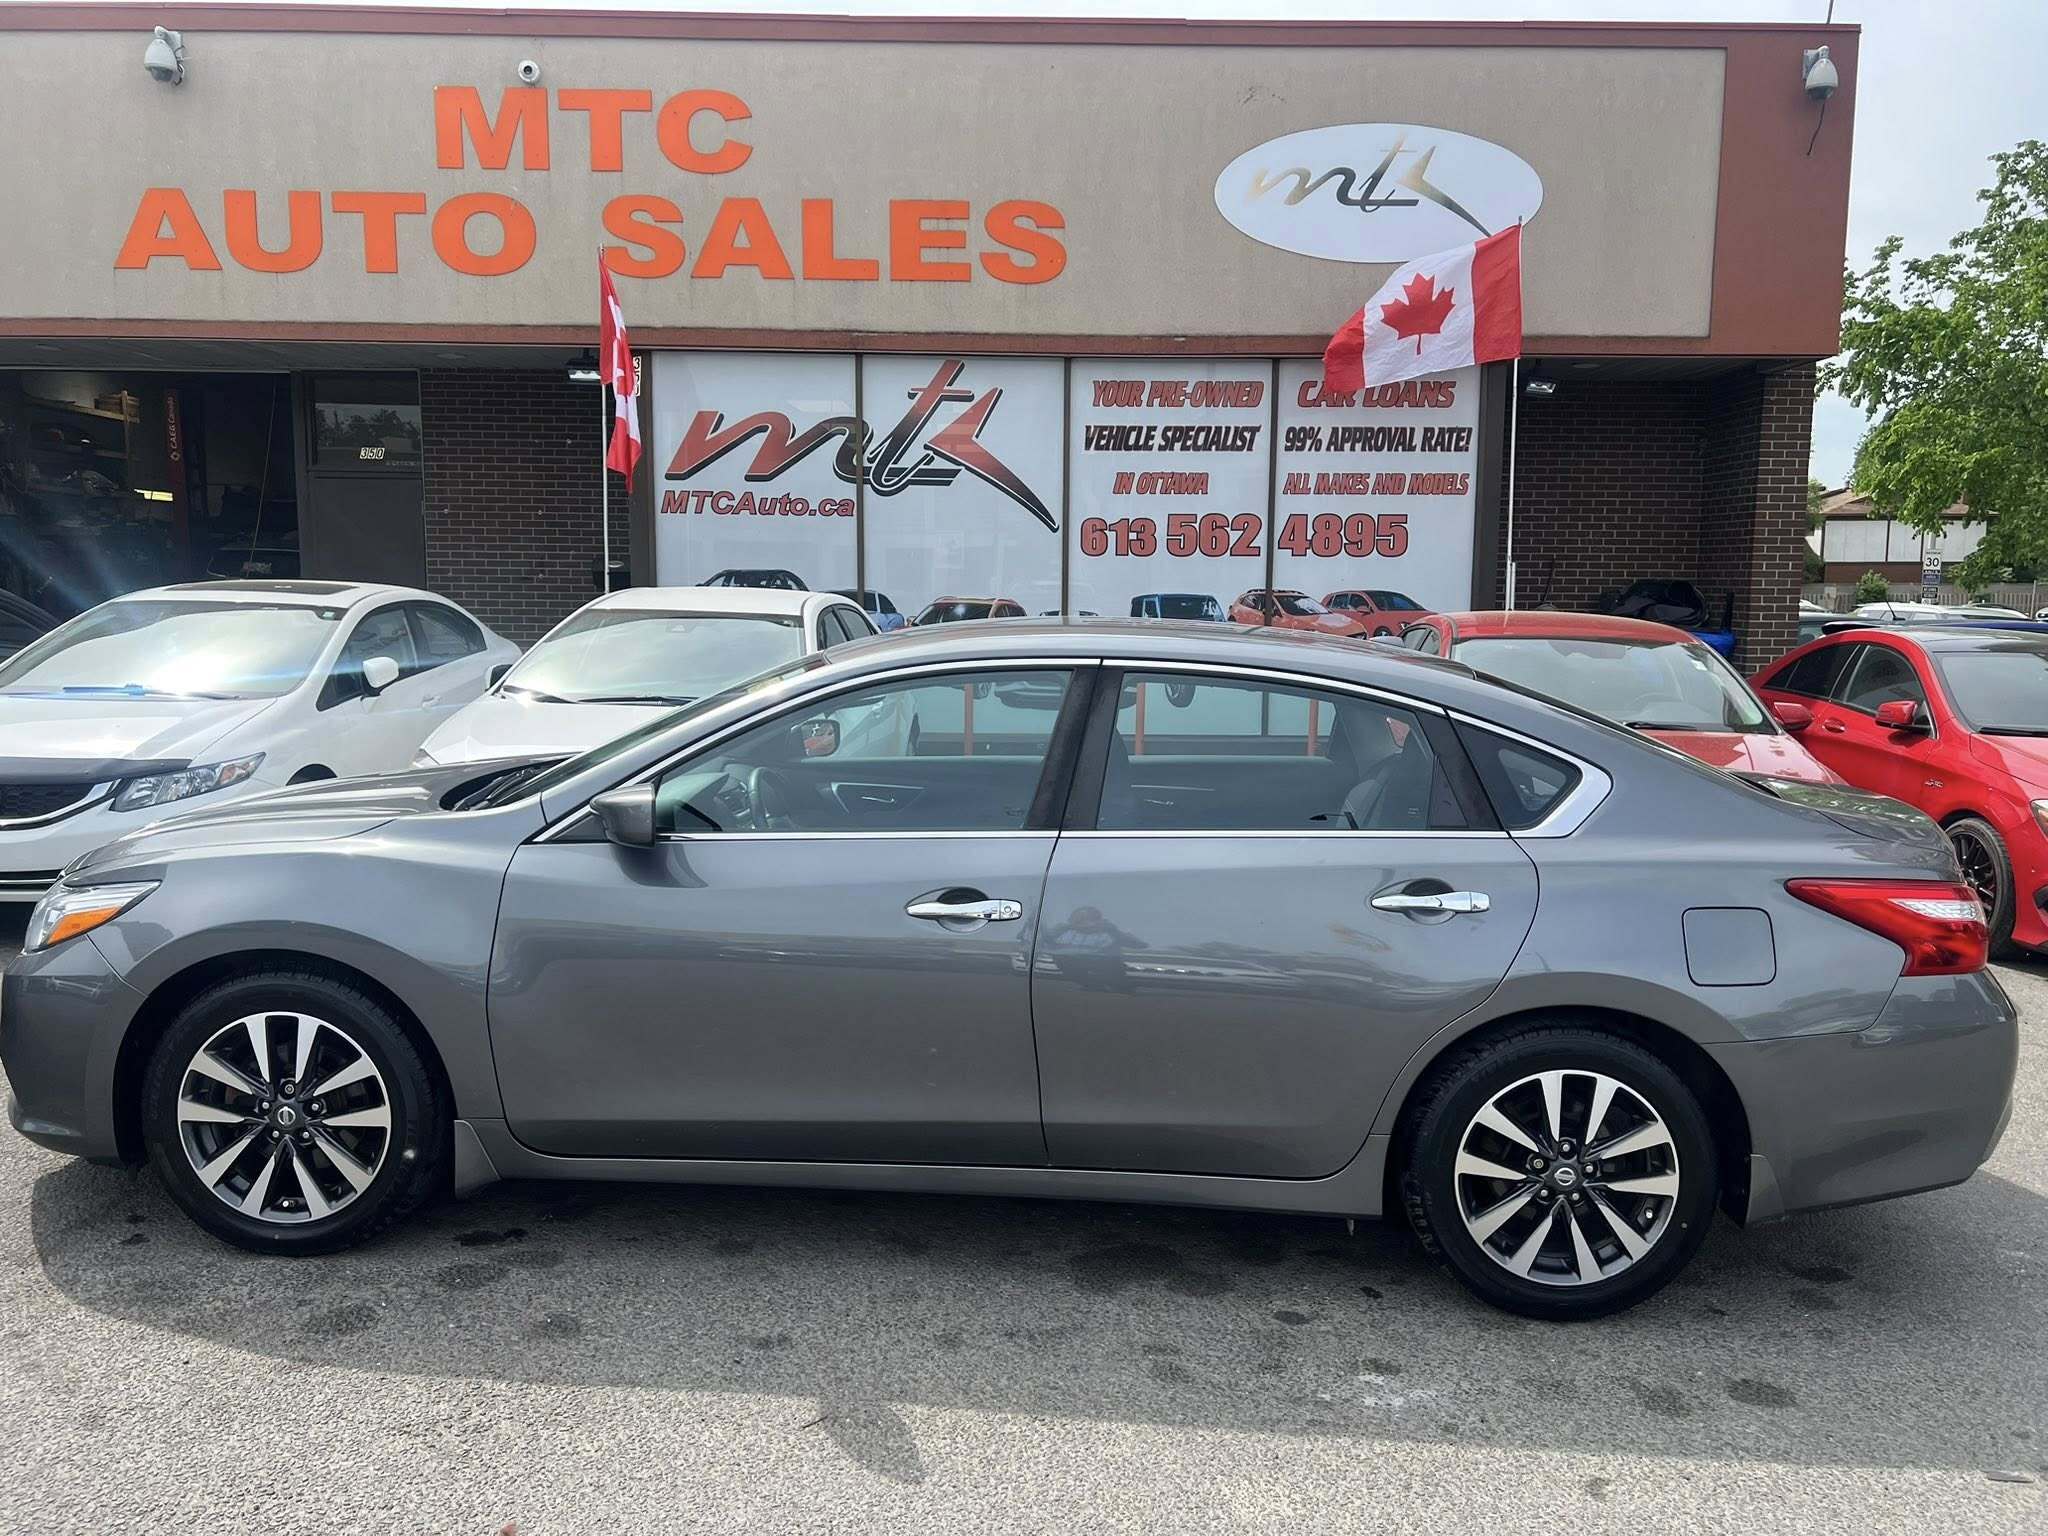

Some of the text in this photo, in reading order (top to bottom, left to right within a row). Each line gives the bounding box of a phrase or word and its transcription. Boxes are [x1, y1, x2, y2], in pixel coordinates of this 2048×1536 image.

[434, 86, 753, 174] MTC
[114, 188, 1067, 284] AUTO SALES
[1092, 380, 1265, 408] YOUR PRE-OWNED
[1362, 380, 1457, 408] LOANS
[1085, 424, 1262, 452] VEHICLE SPECIALIST
[1284, 426, 1473, 452] 99% APPROVAL RATE!
[360, 447, 385, 460] 350
[1112, 471, 1209, 494] IN OTTAWA
[1283, 473, 1470, 495] ALL MAKES AND MODELS
[661, 489, 856, 518] MTCAuto.ca
[1080, 512, 1409, 558] 613 562 4895
[1925, 557, 1940, 567] 30
